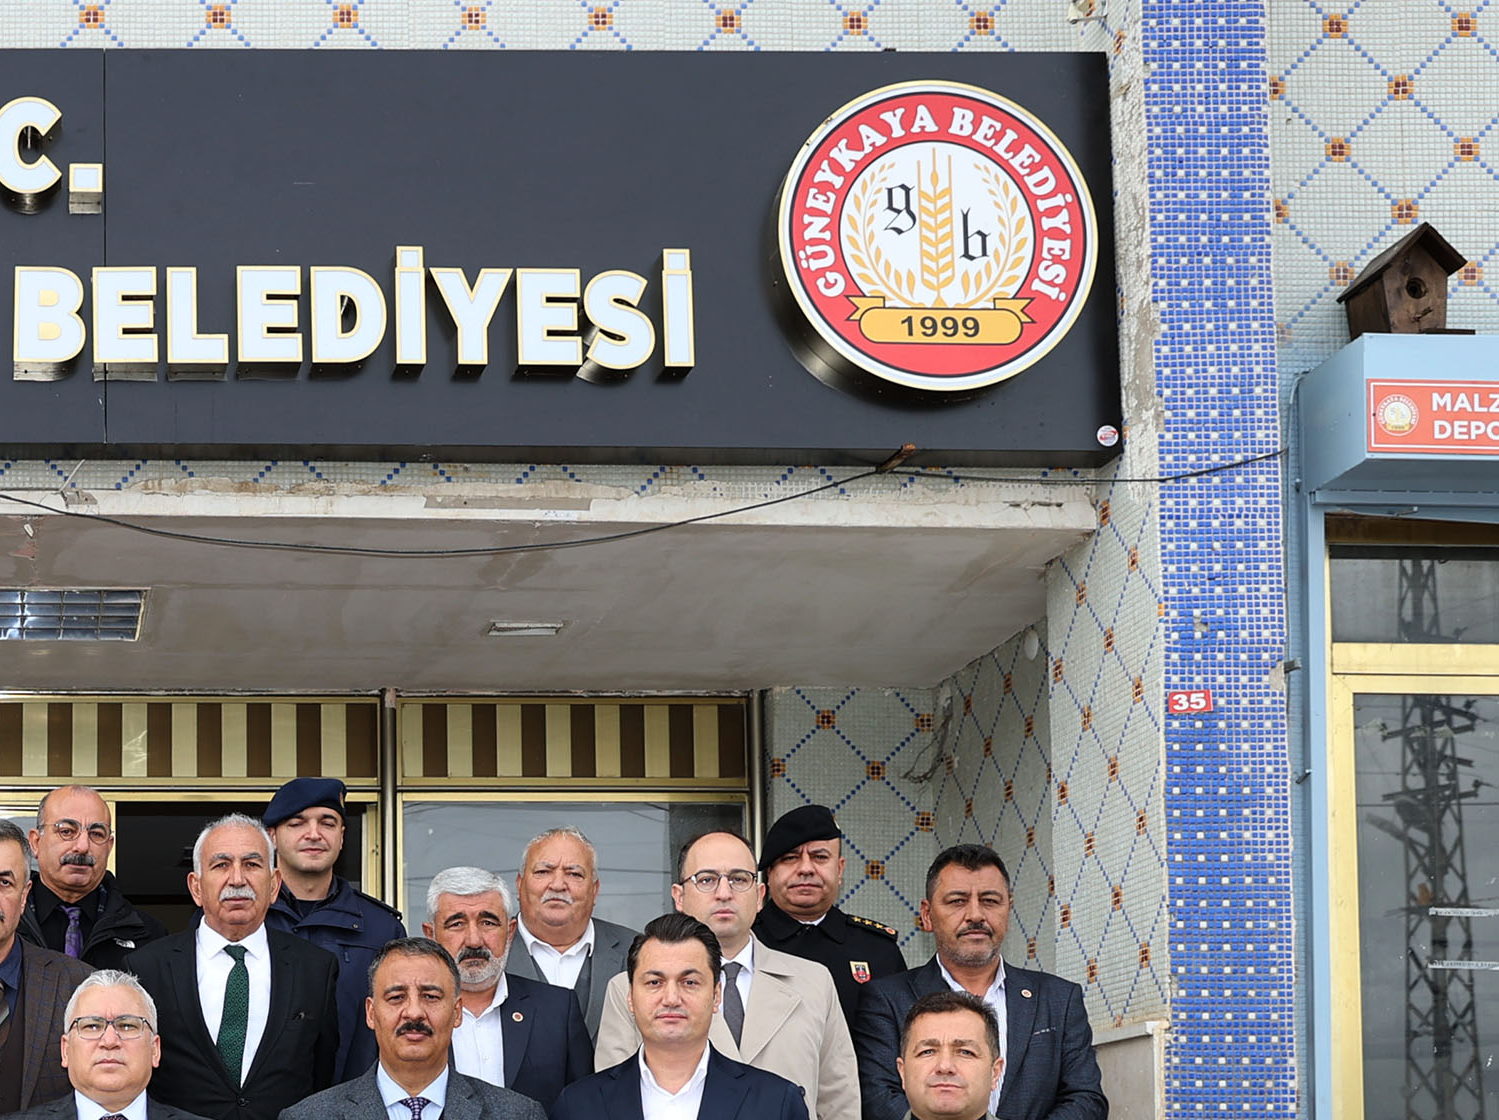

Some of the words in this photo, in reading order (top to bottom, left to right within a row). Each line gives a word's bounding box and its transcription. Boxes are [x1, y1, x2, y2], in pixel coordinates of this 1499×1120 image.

[798, 104, 939, 298] GÜNEYKAYA
[947, 106, 1073, 302] BELEDİYESİ
[12, 244, 696, 371] BELEDİYESİ
[900, 315, 981, 338] 1999
[1172, 692, 1207, 711] 35
